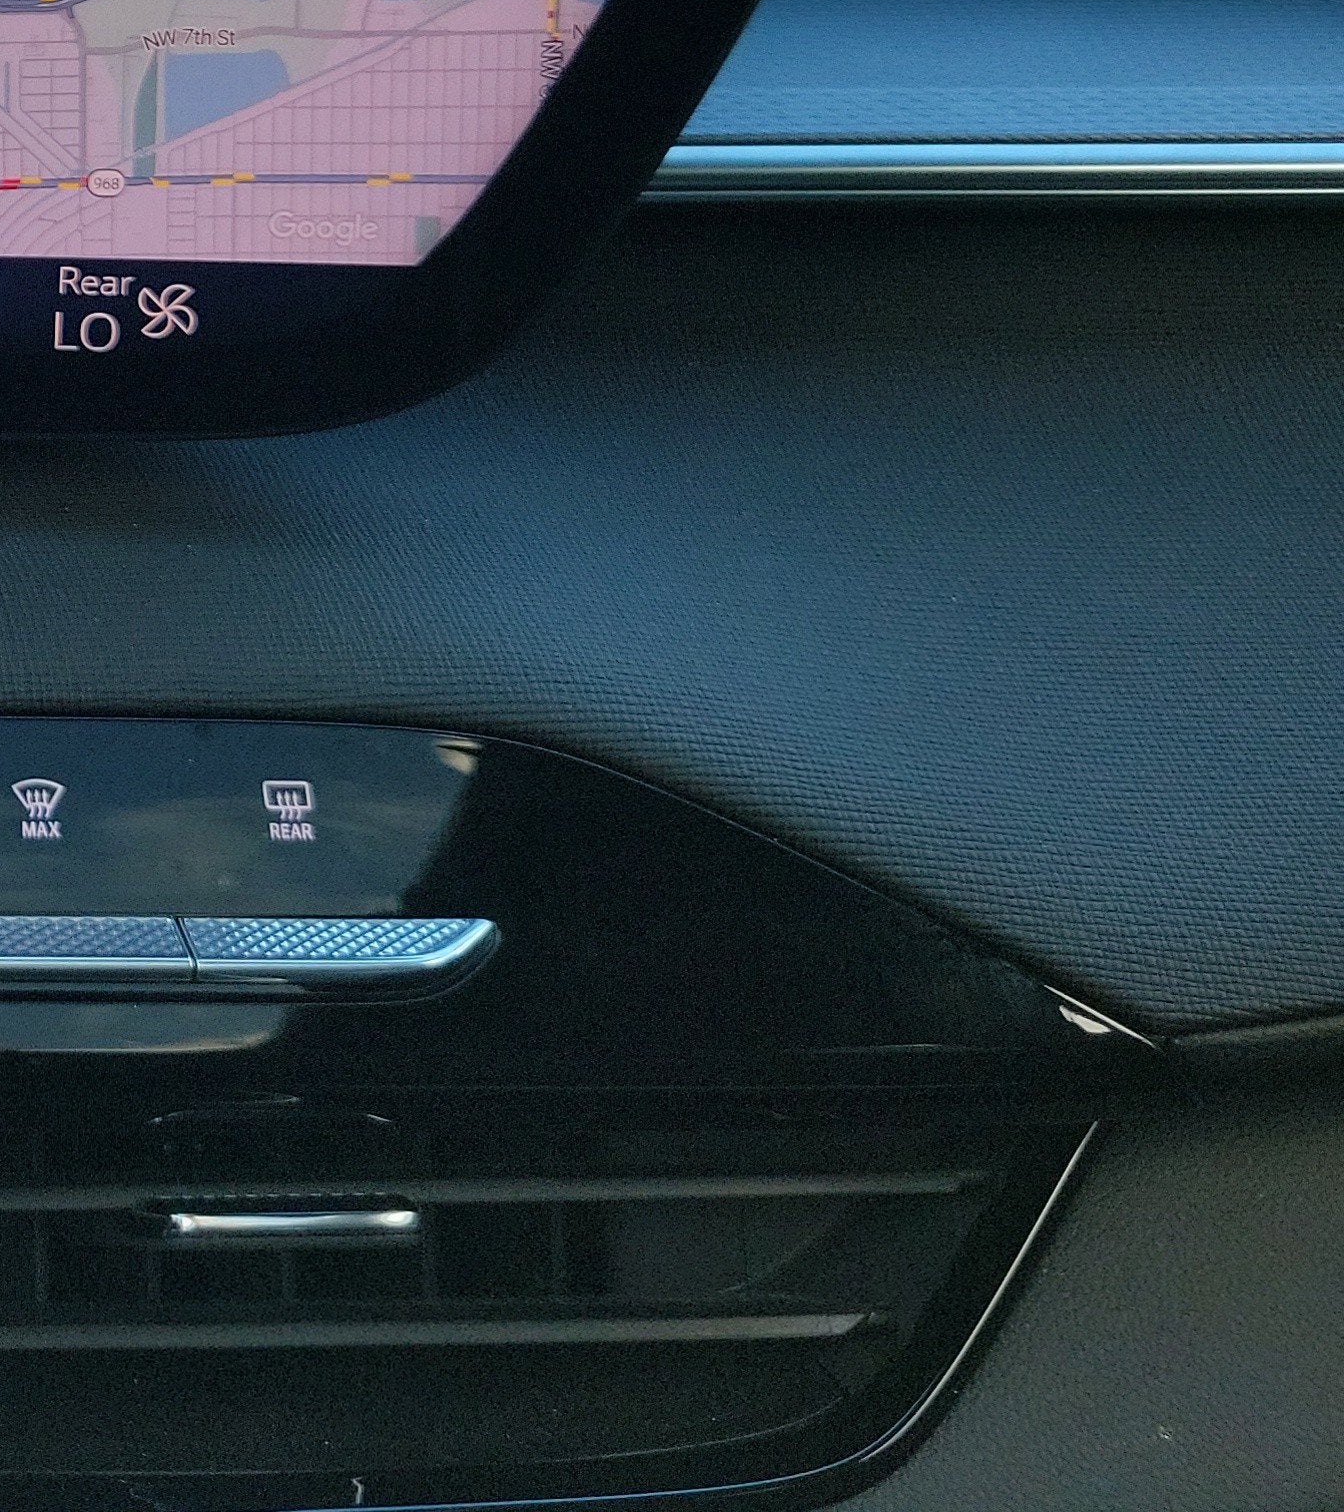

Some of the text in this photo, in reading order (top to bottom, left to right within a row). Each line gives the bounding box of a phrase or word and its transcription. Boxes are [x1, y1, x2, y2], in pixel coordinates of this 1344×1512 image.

[142, 29, 236, 50] NW 7th St
[94, 177, 119, 190] 968
[268, 211, 379, 246] Google
[59, 266, 135, 296] Rear
[54, 311, 121, 352] LO
[21, 820, 62, 839] MAX
[269, 821, 314, 841] REAR
